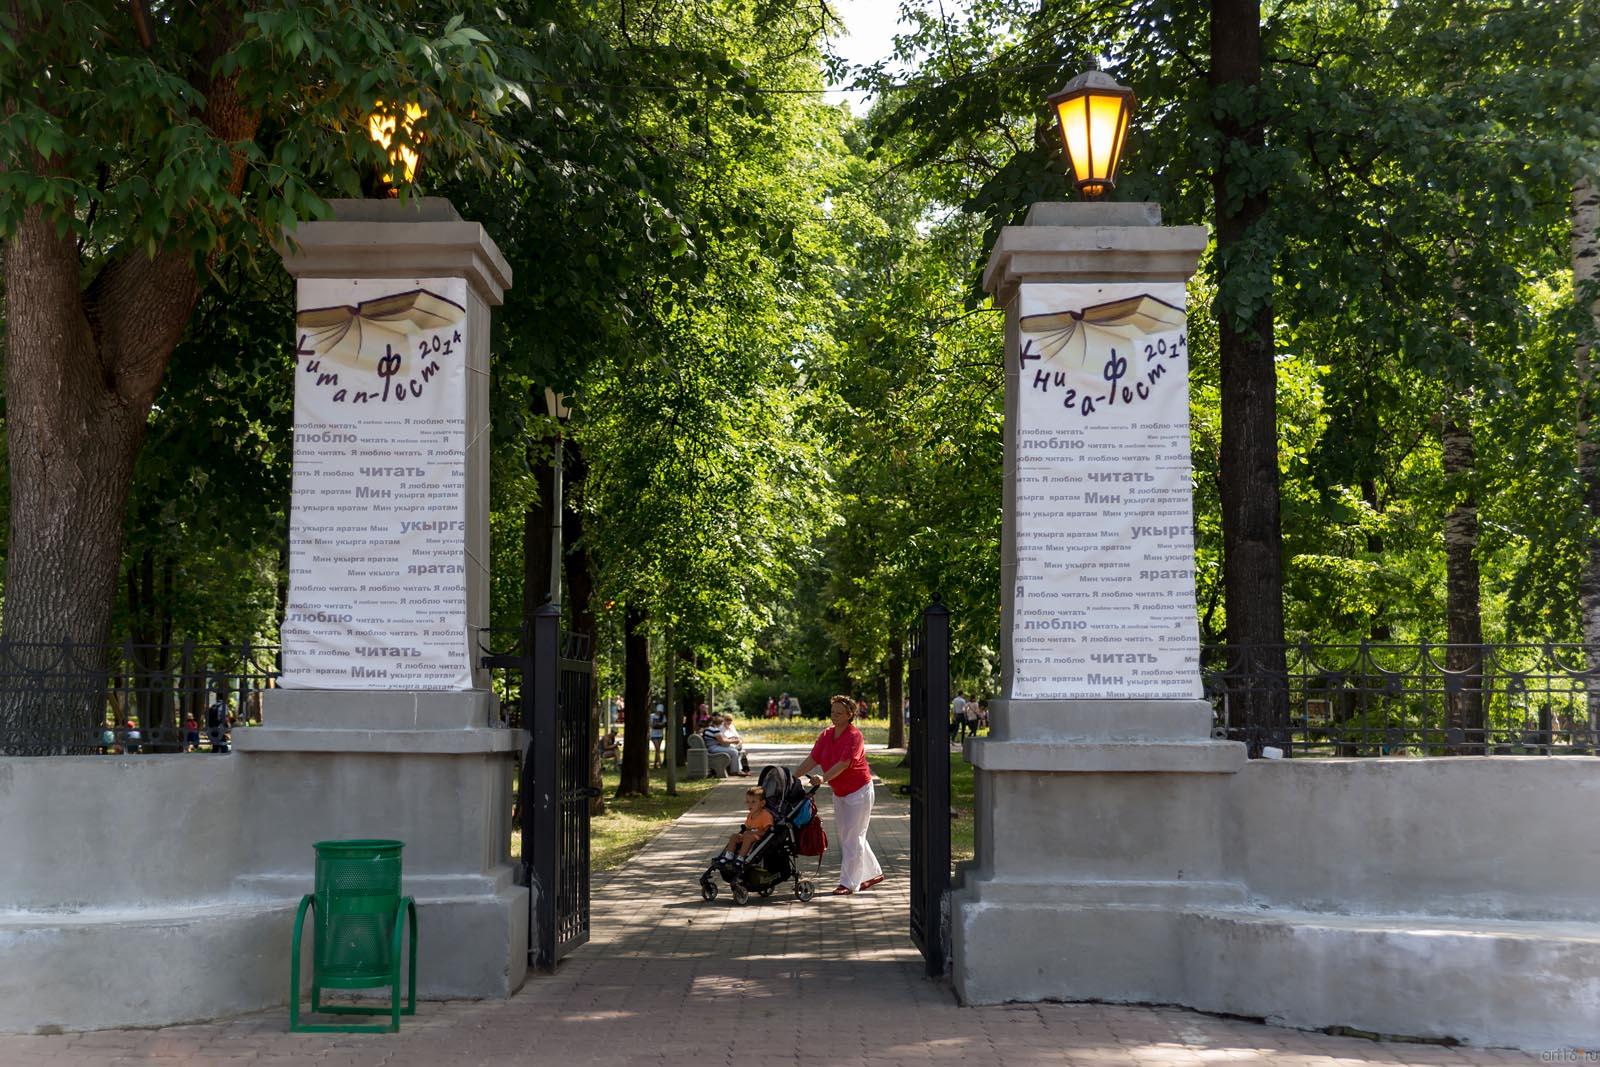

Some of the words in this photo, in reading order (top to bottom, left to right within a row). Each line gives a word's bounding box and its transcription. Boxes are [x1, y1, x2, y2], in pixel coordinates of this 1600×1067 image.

[419, 330, 462, 359] 2014
[1144, 333, 1187, 362] 2014
[1020, 340, 1167, 416] Книга-фест
[296, 432, 357, 443] люблю
[1023, 438, 1084, 449] люблю
[360, 466, 425, 477] читать
[1088, 471, 1154, 482] читать
[355, 486, 391, 498] Мин
[1085, 492, 1120, 504] Мин
[1016, 587, 1024, 598] Я
[291, 611, 352, 622] люблю
[1024, 619, 1087, 630] люблю
[355, 646, 421, 657] читать
[1090, 653, 1158, 664] читать
[352, 666, 387, 678] Мин
[1087, 674, 1123, 685] Мин
